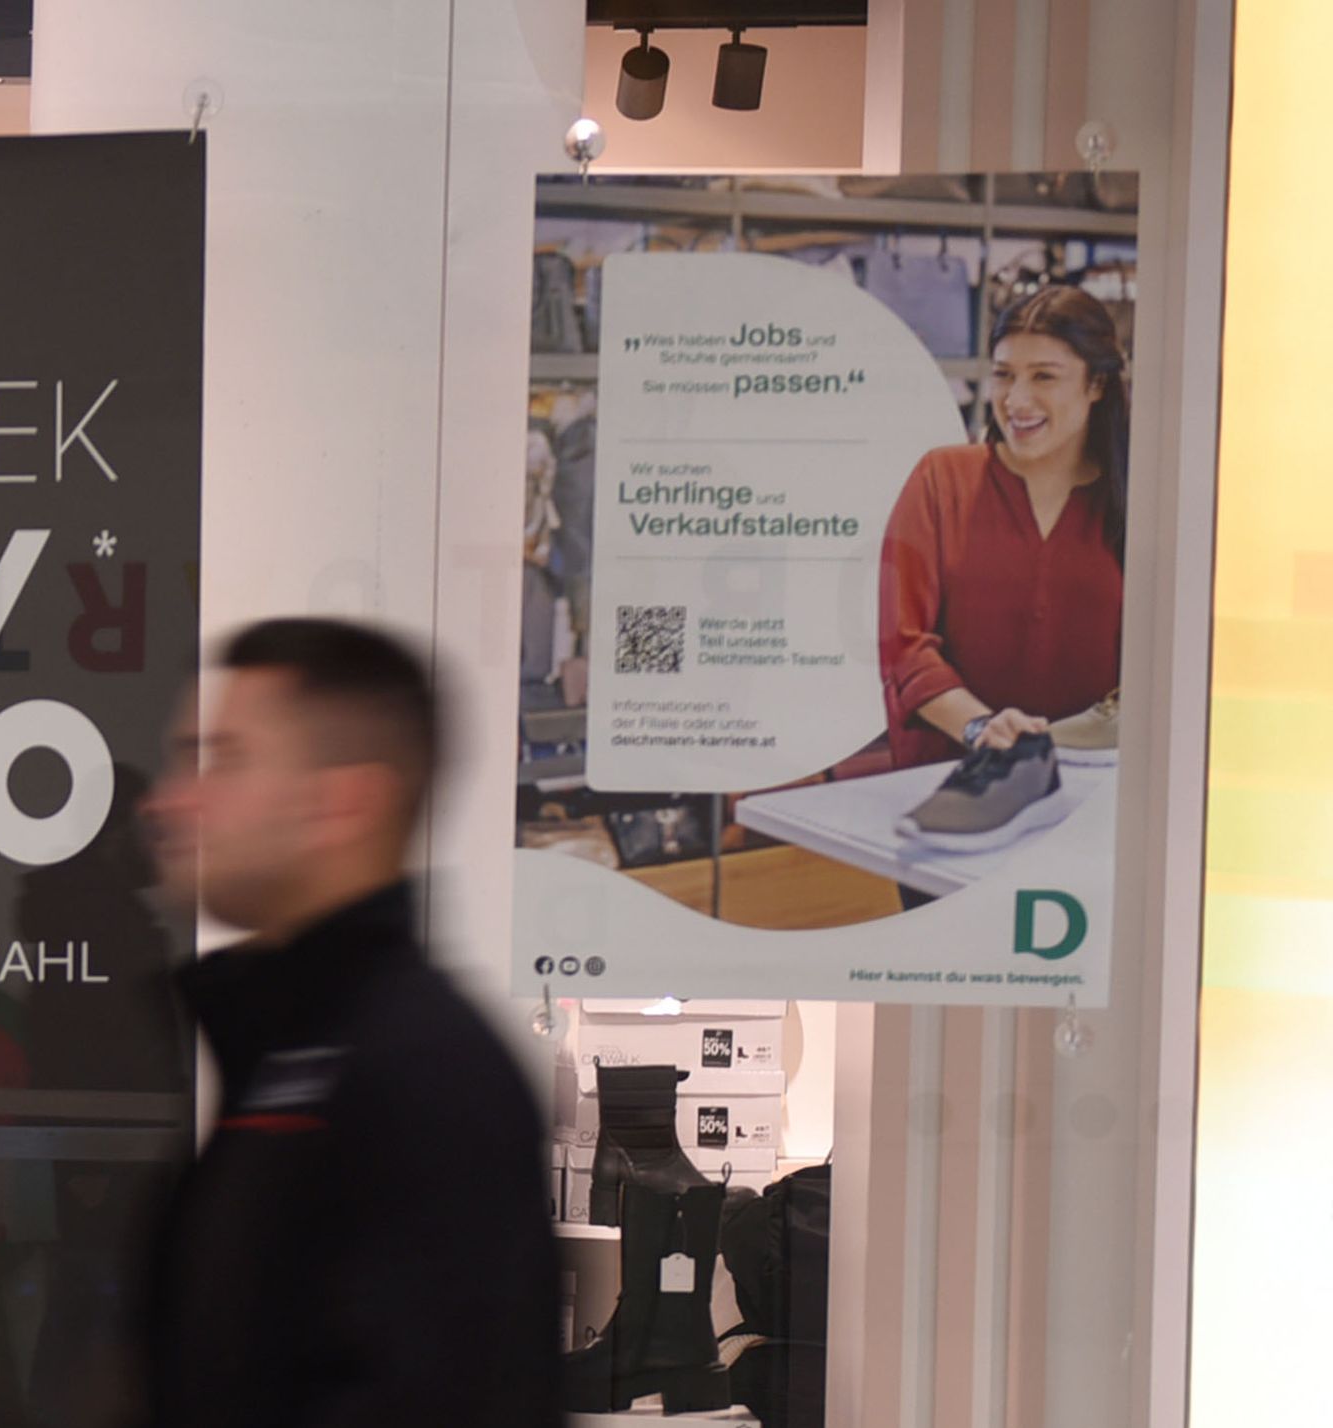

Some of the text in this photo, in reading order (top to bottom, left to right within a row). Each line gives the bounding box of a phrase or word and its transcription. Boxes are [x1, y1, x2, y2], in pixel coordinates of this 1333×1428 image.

[730, 323, 803, 347] Jobs
[806, 335, 836, 346] und
[642, 380, 666, 393] Sie
[631, 463, 712, 475] Wir suchen
[618, 481, 753, 510] Lehrlinge
[629, 512, 860, 537] Verkaufstalente
[1013, 889, 1089, 961] D
[849, 969, 883, 982] Hier
[886, 969, 942, 982] kannst
[946, 971, 966, 983] du
[970, 973, 1003, 983] was
